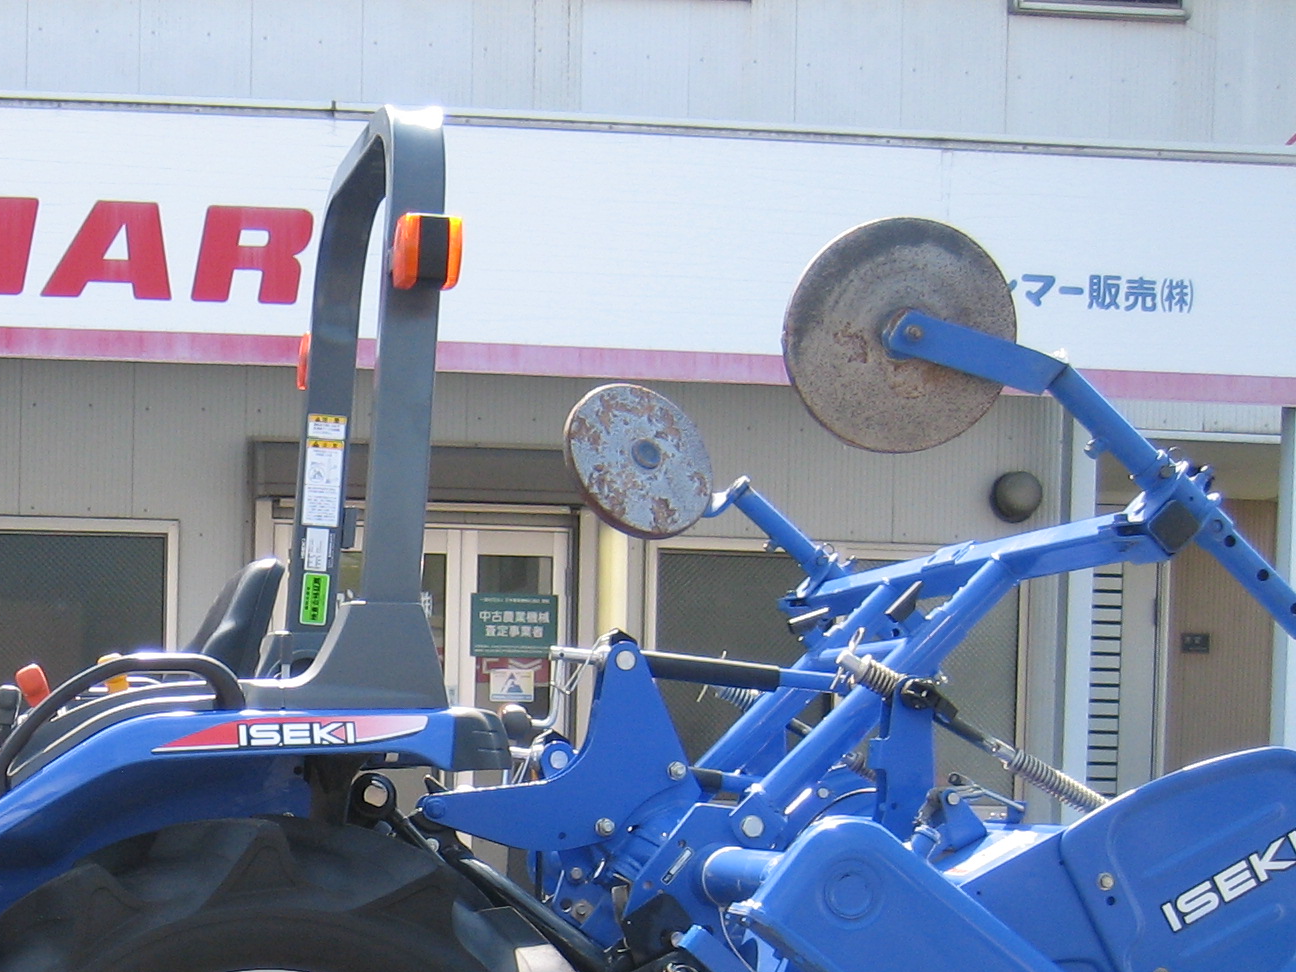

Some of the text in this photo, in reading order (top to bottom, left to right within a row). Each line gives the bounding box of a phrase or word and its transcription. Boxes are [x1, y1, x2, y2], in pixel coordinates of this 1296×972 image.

[1007, 273, 1194, 313] マー販売(株)
[238, 722, 356, 747] ISEKI
